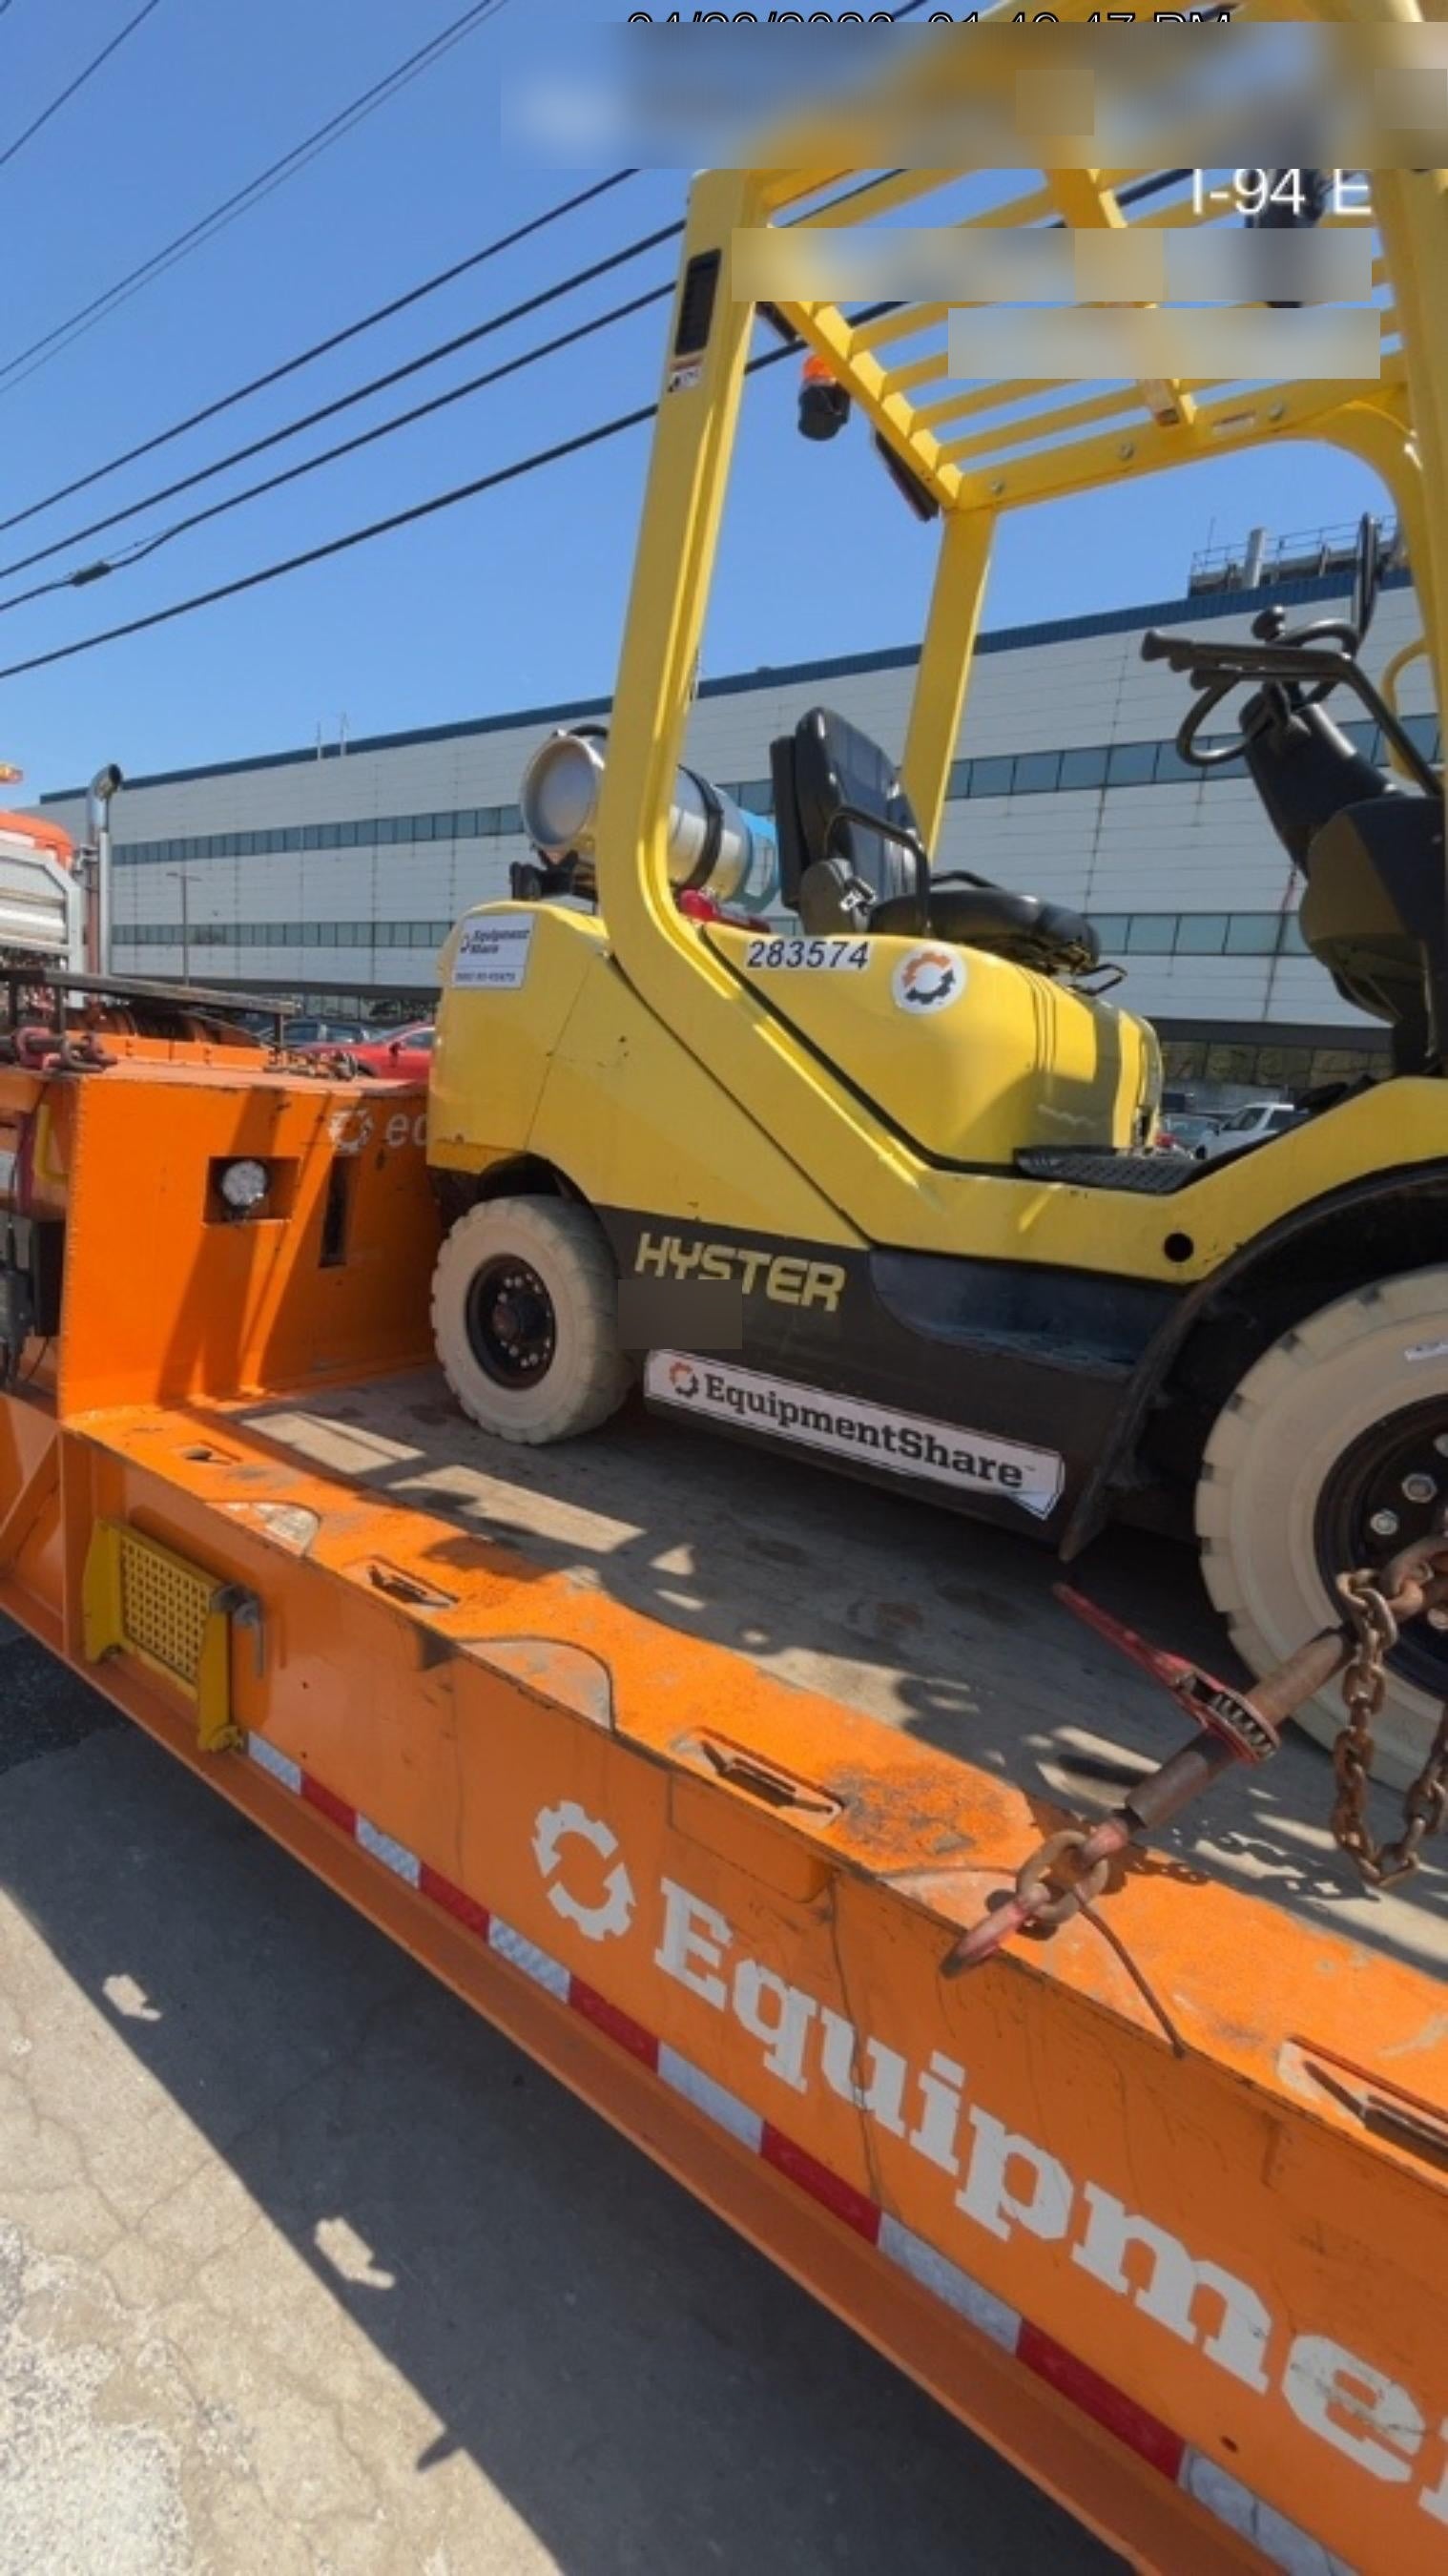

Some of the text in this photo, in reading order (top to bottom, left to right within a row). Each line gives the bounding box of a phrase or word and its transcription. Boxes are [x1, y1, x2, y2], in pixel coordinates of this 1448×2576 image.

[747, 938, 870, 970] 283574
[634, 1232, 846, 1313] HYSTER
[704, 1371, 1023, 1489] EquipmentShare
[652, 1877, 1448, 2527] Equipme
